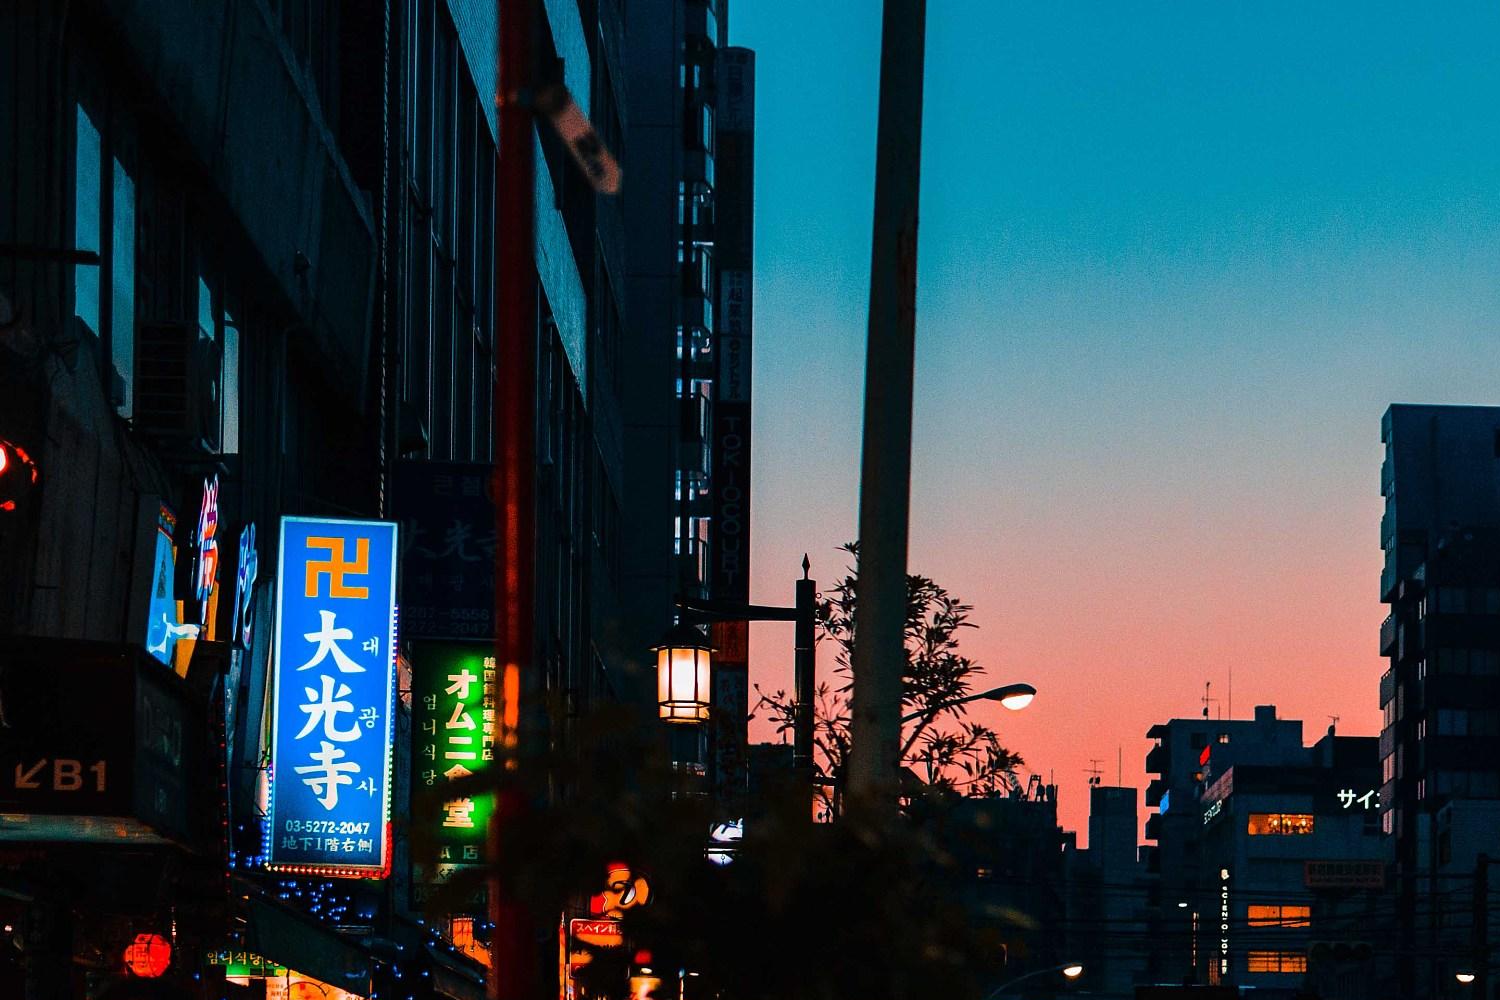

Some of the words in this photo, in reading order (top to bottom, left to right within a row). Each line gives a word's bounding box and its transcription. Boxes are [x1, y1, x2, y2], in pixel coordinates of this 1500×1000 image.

[294, 609, 367, 811] 大光寺
[355, 637, 380, 798] 대광사
[53, 757, 107, 792] B1
[1336, 788, 1381, 810] サイ
[285, 819, 370, 835] 03-5272-2047
[281, 835, 373, 853] 地下1階右側
